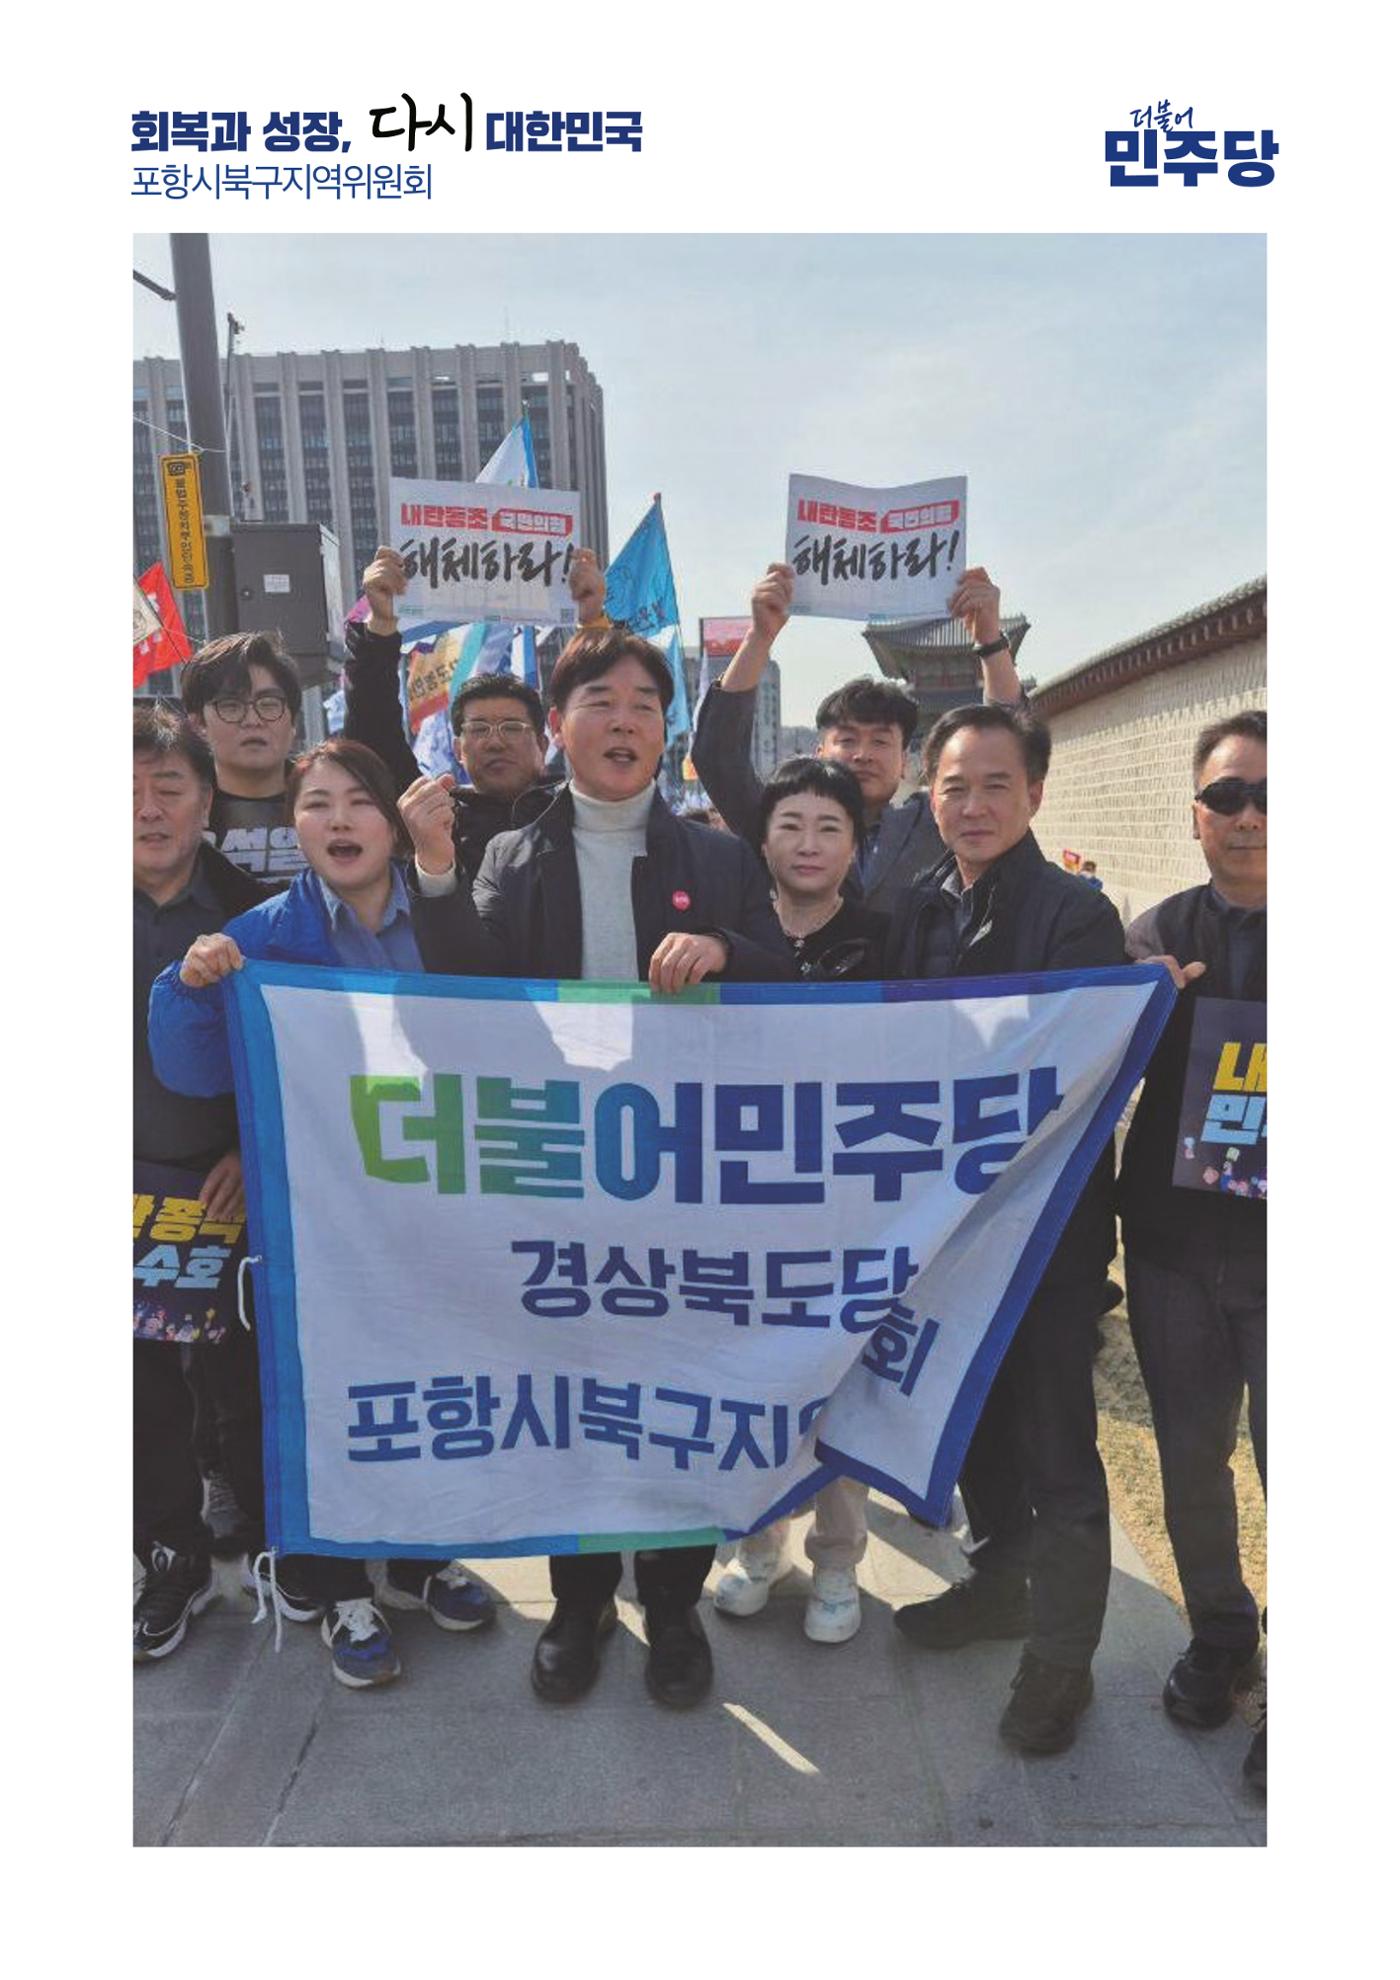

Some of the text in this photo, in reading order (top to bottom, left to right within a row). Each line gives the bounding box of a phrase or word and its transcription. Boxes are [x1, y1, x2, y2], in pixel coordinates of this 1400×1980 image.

[400, 503, 488, 530] 내란동조
[797, 498, 877, 533] 내란동조
[399, 537, 574, 589] 해체하라!
[792, 530, 960, 586] 해체하라!
[350, 1066, 1064, 1205] 더불어민주당
[511, 1240, 919, 1334] 경상북도당
